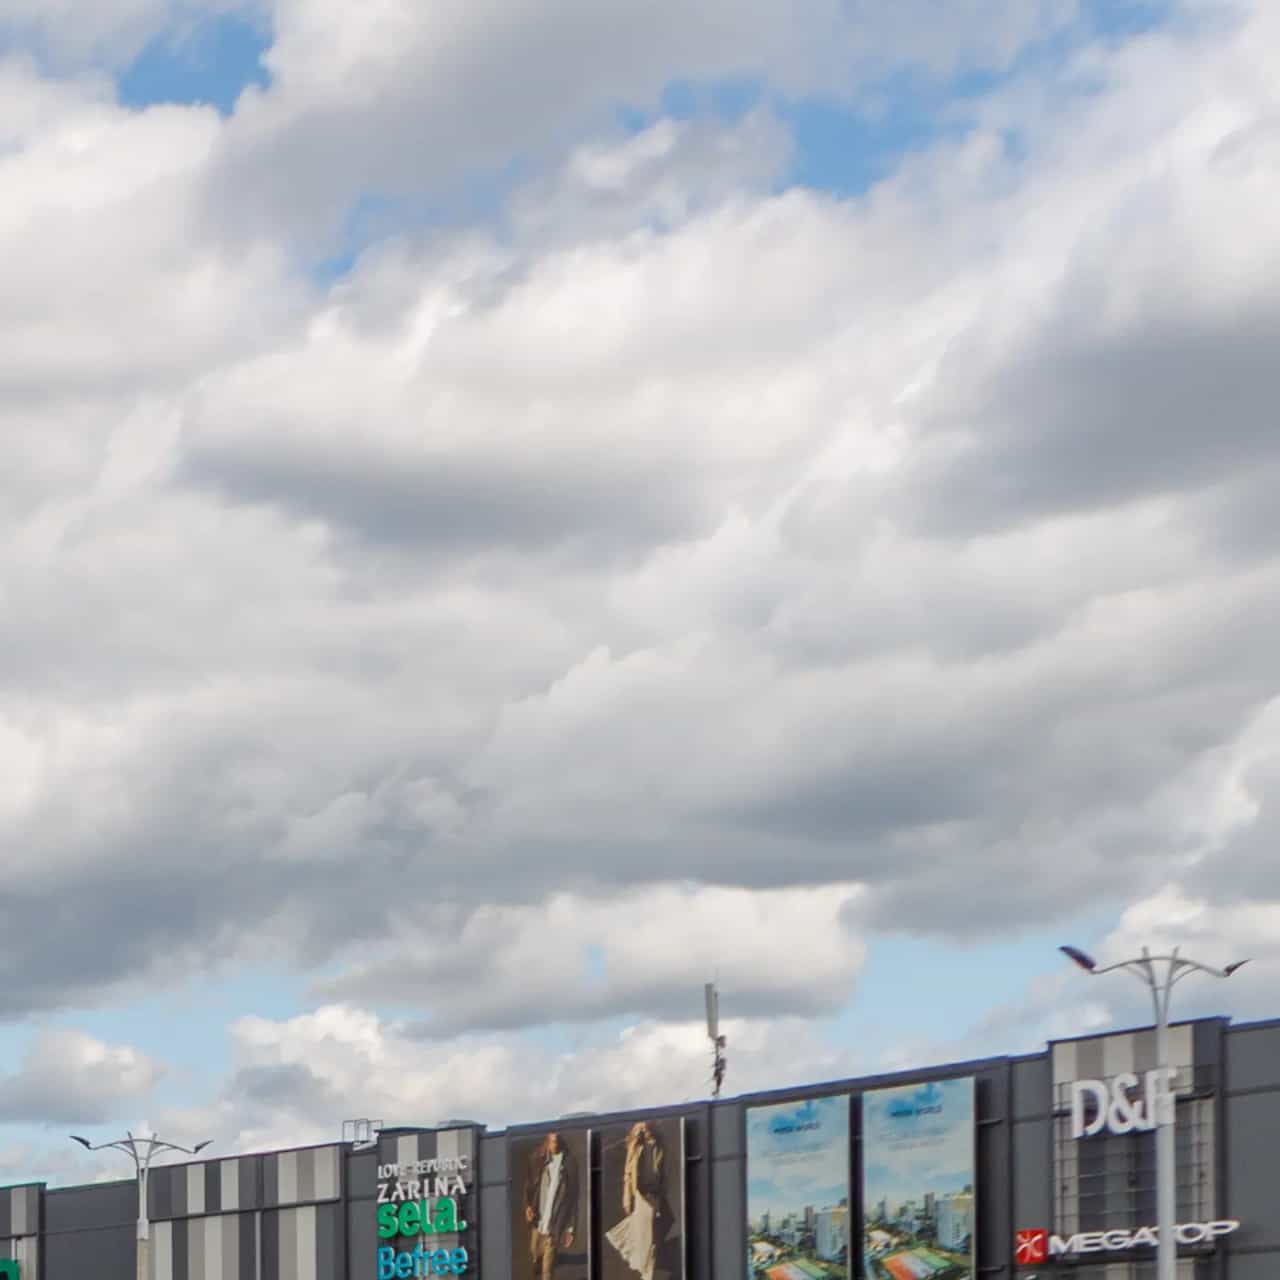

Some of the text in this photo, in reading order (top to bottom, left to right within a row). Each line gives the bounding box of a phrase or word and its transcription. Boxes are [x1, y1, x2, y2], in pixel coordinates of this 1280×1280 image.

[377, 1175, 468, 1204] ZARINA
[1047, 1219, 1240, 1255] MEGAOP
[377, 1242, 469, 1280] Befree
